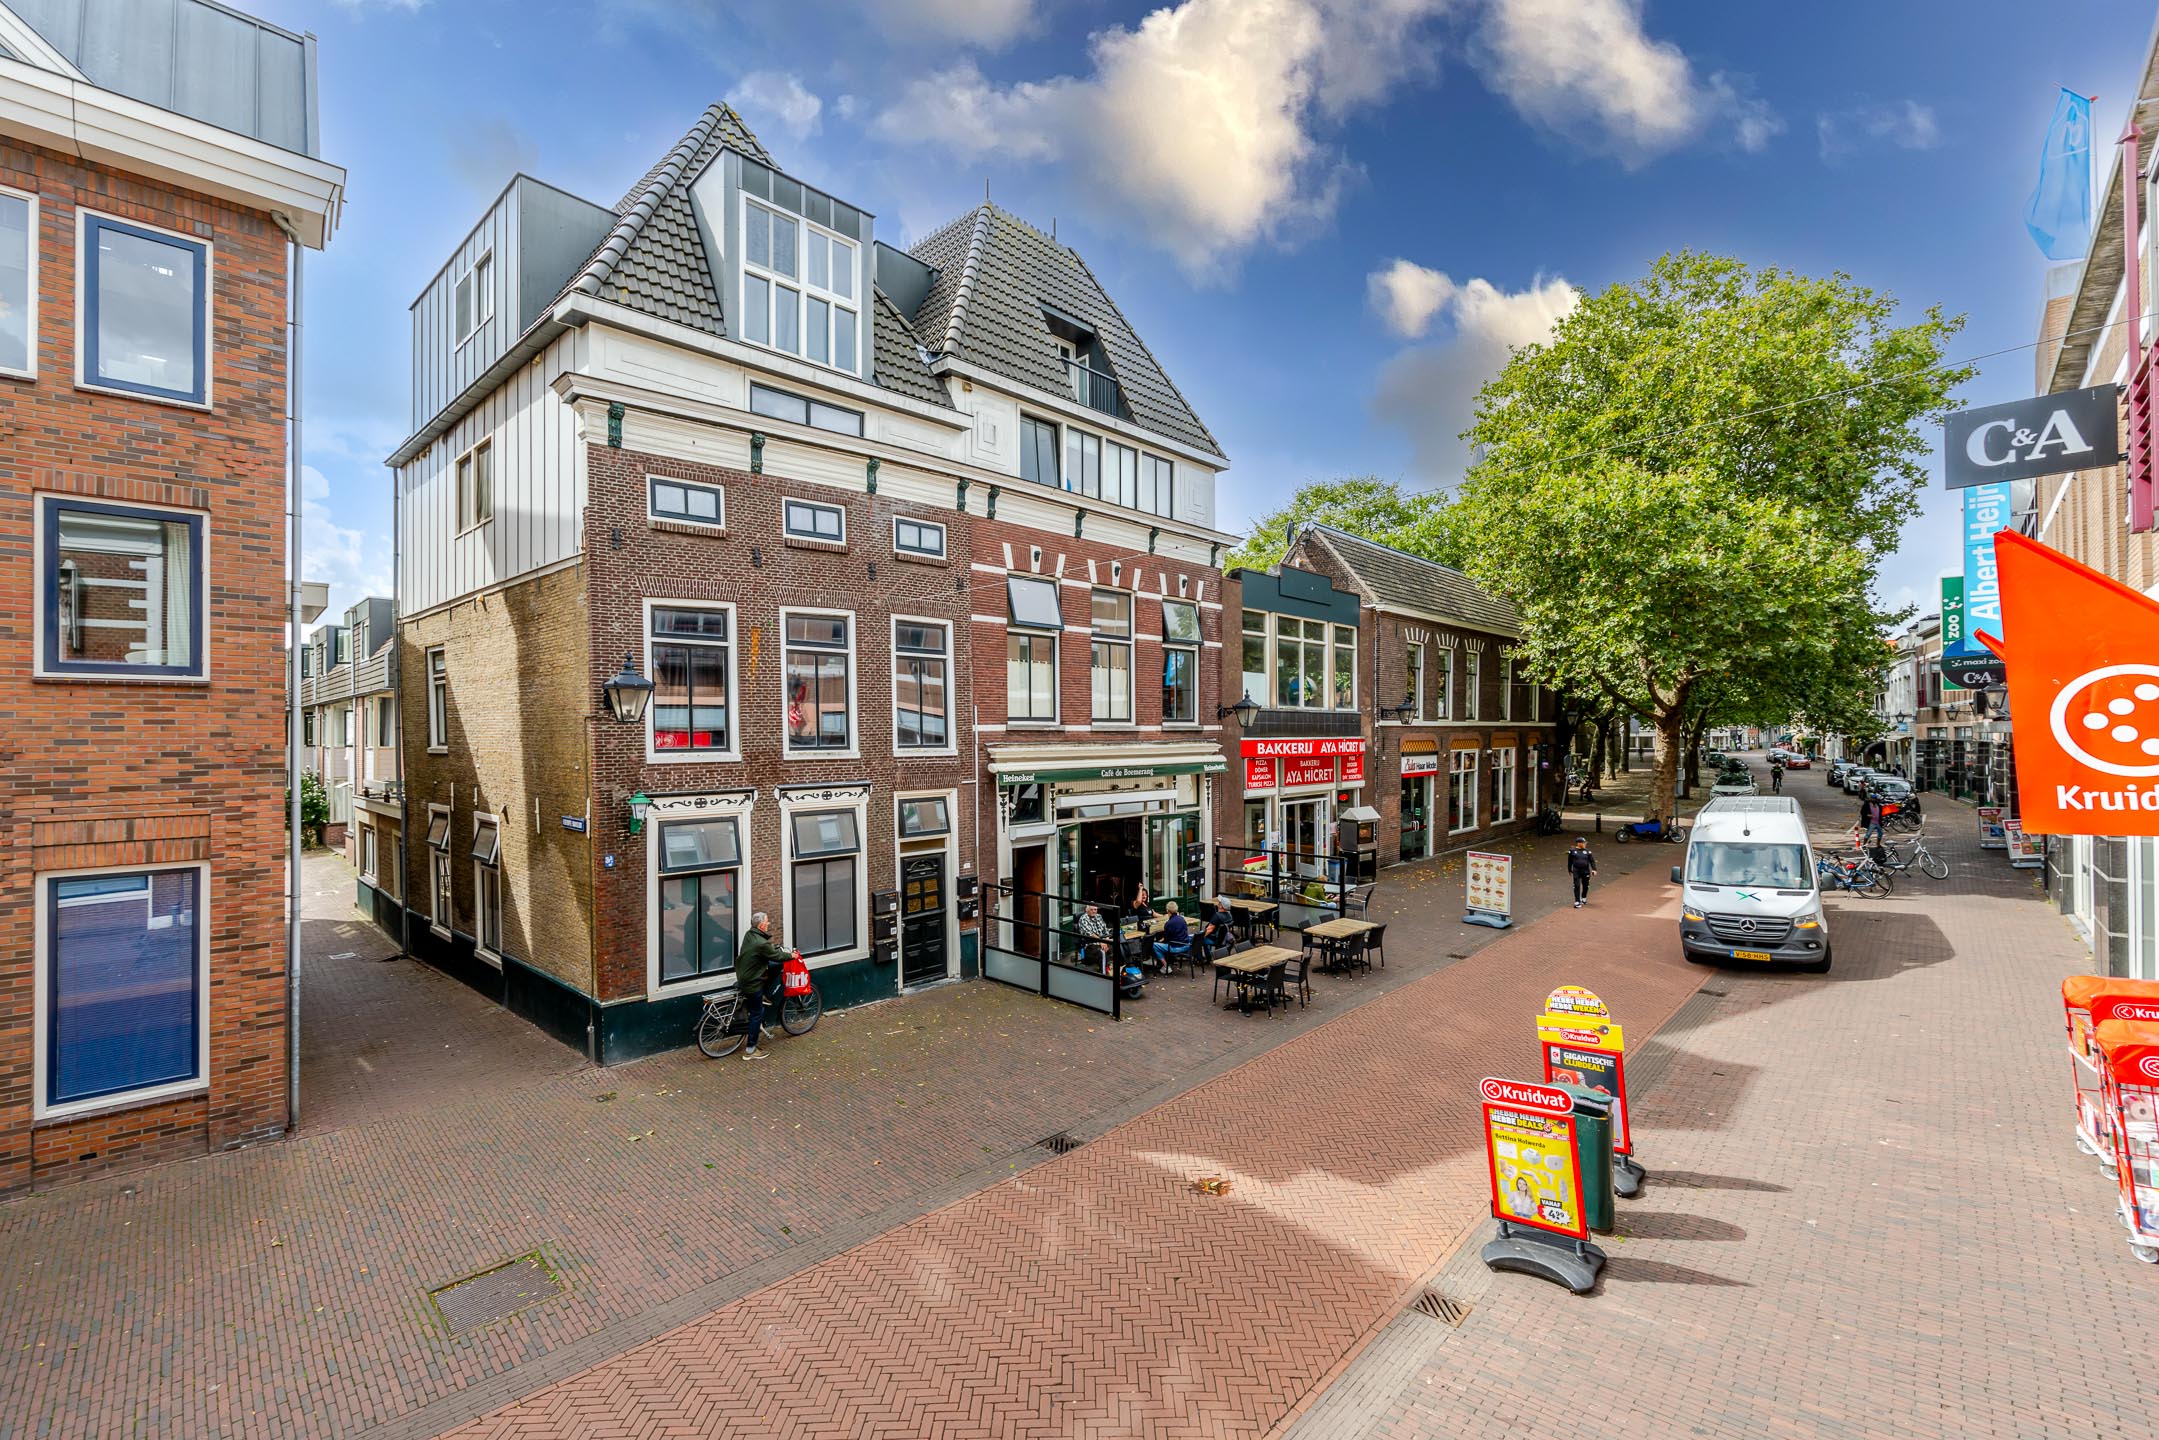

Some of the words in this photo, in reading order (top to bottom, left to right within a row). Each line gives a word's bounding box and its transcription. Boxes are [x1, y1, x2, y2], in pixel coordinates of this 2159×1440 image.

[1966, 409, 2094, 467] C&A
[1969, 546, 2000, 620] Albert
[1947, 614, 1960, 639] zoo
[1963, 657, 1987, 666] maxi
[1963, 671, 1993, 684] C&A
[1257, 741, 1313, 755] BAKKERIJ
[1320, 741, 1337, 753] AYA
[1003, 773, 1035, 782] Heineken
[1101, 768, 1114, 777] Café
[1115, 767, 1123, 777] de
[1123, 767, 1154, 776] Boemerang
[1286, 771, 1302, 784] AYA
[2056, 783, 2159, 811] Kruid
[785, 971, 809, 988] Dirk
[2135, 1007, 2159, 1019] Kru
[1569, 1033, 1598, 1044] Kruidvat
[1563, 1052, 1615, 1067] GIGANTISCHE
[1563, 1058, 1605, 1073] CLUBDEAL!
[1502, 1085, 1566, 1108] Kruidvat
[1490, 1114, 1517, 1126] HEBBE
[1517, 1119, 1544, 1130] DEALS
